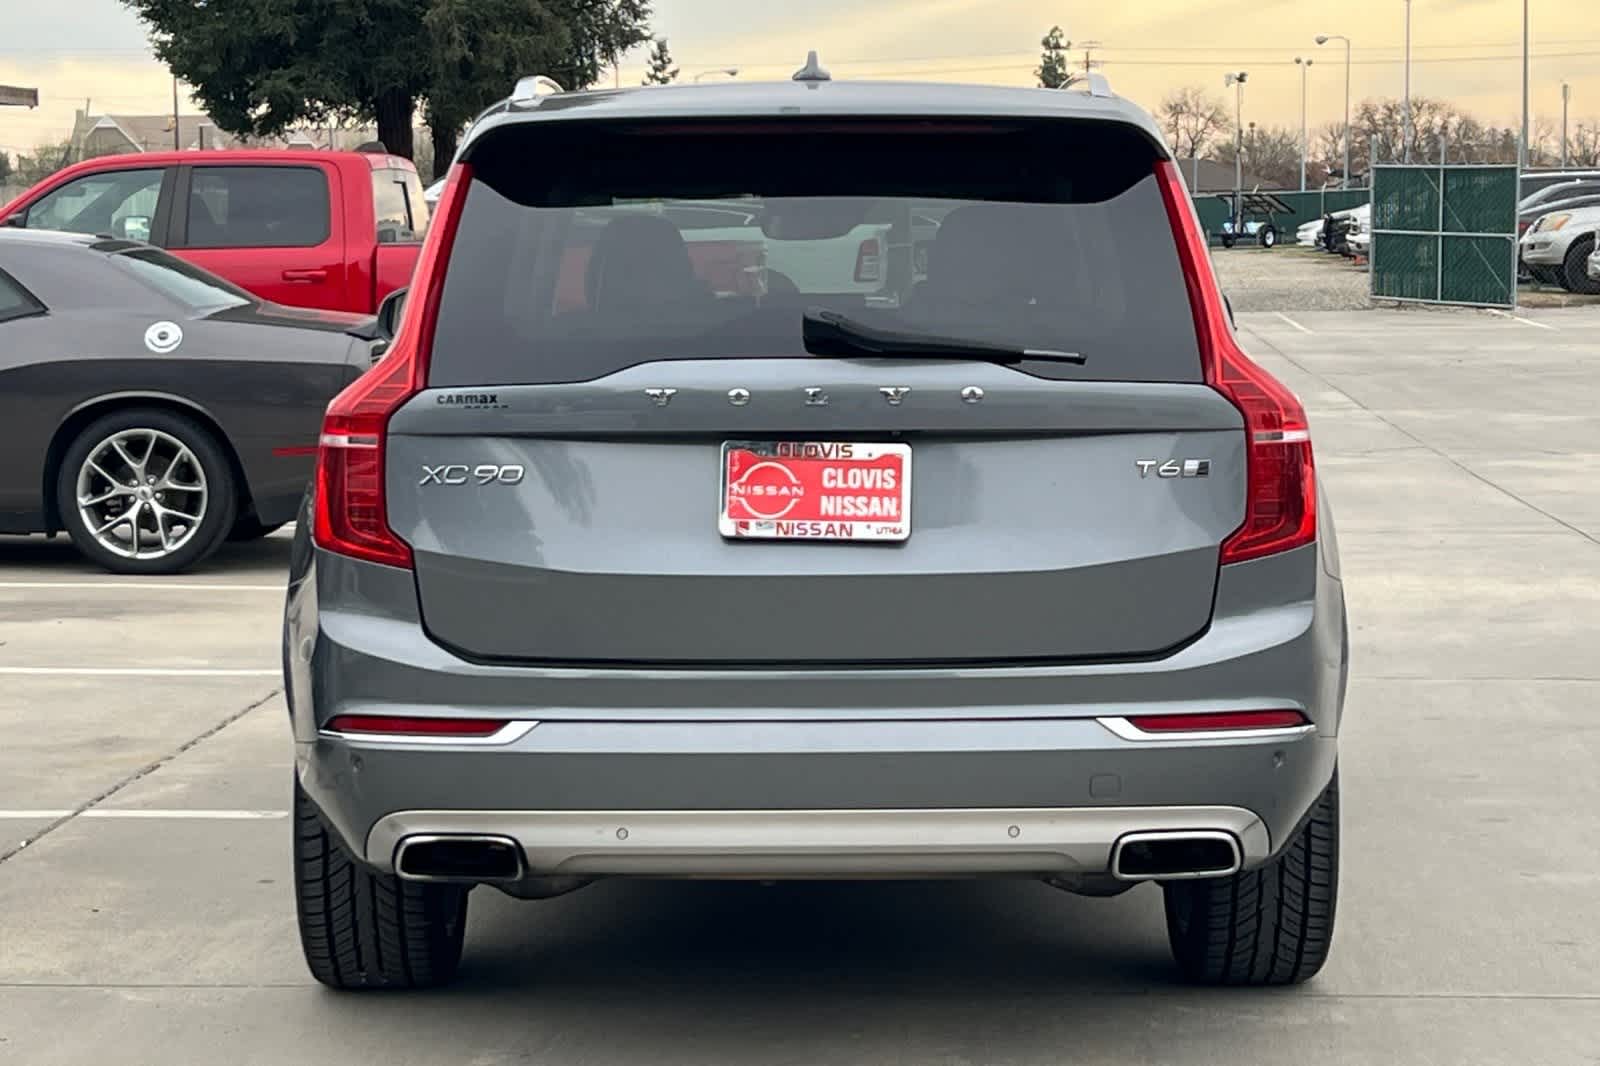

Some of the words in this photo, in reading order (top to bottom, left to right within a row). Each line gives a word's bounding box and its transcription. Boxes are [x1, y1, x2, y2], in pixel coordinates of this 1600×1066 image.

[645, 386, 984, 407] VOLVO
[778, 442, 853, 459] CLOVIS
[1136, 459, 1181, 478] T6
[822, 467, 896, 490] CLOVIS
[732, 484, 804, 497] NISSAN
[820, 495, 897, 517] NISSAN
[776, 522, 853, 537] NISSAN
